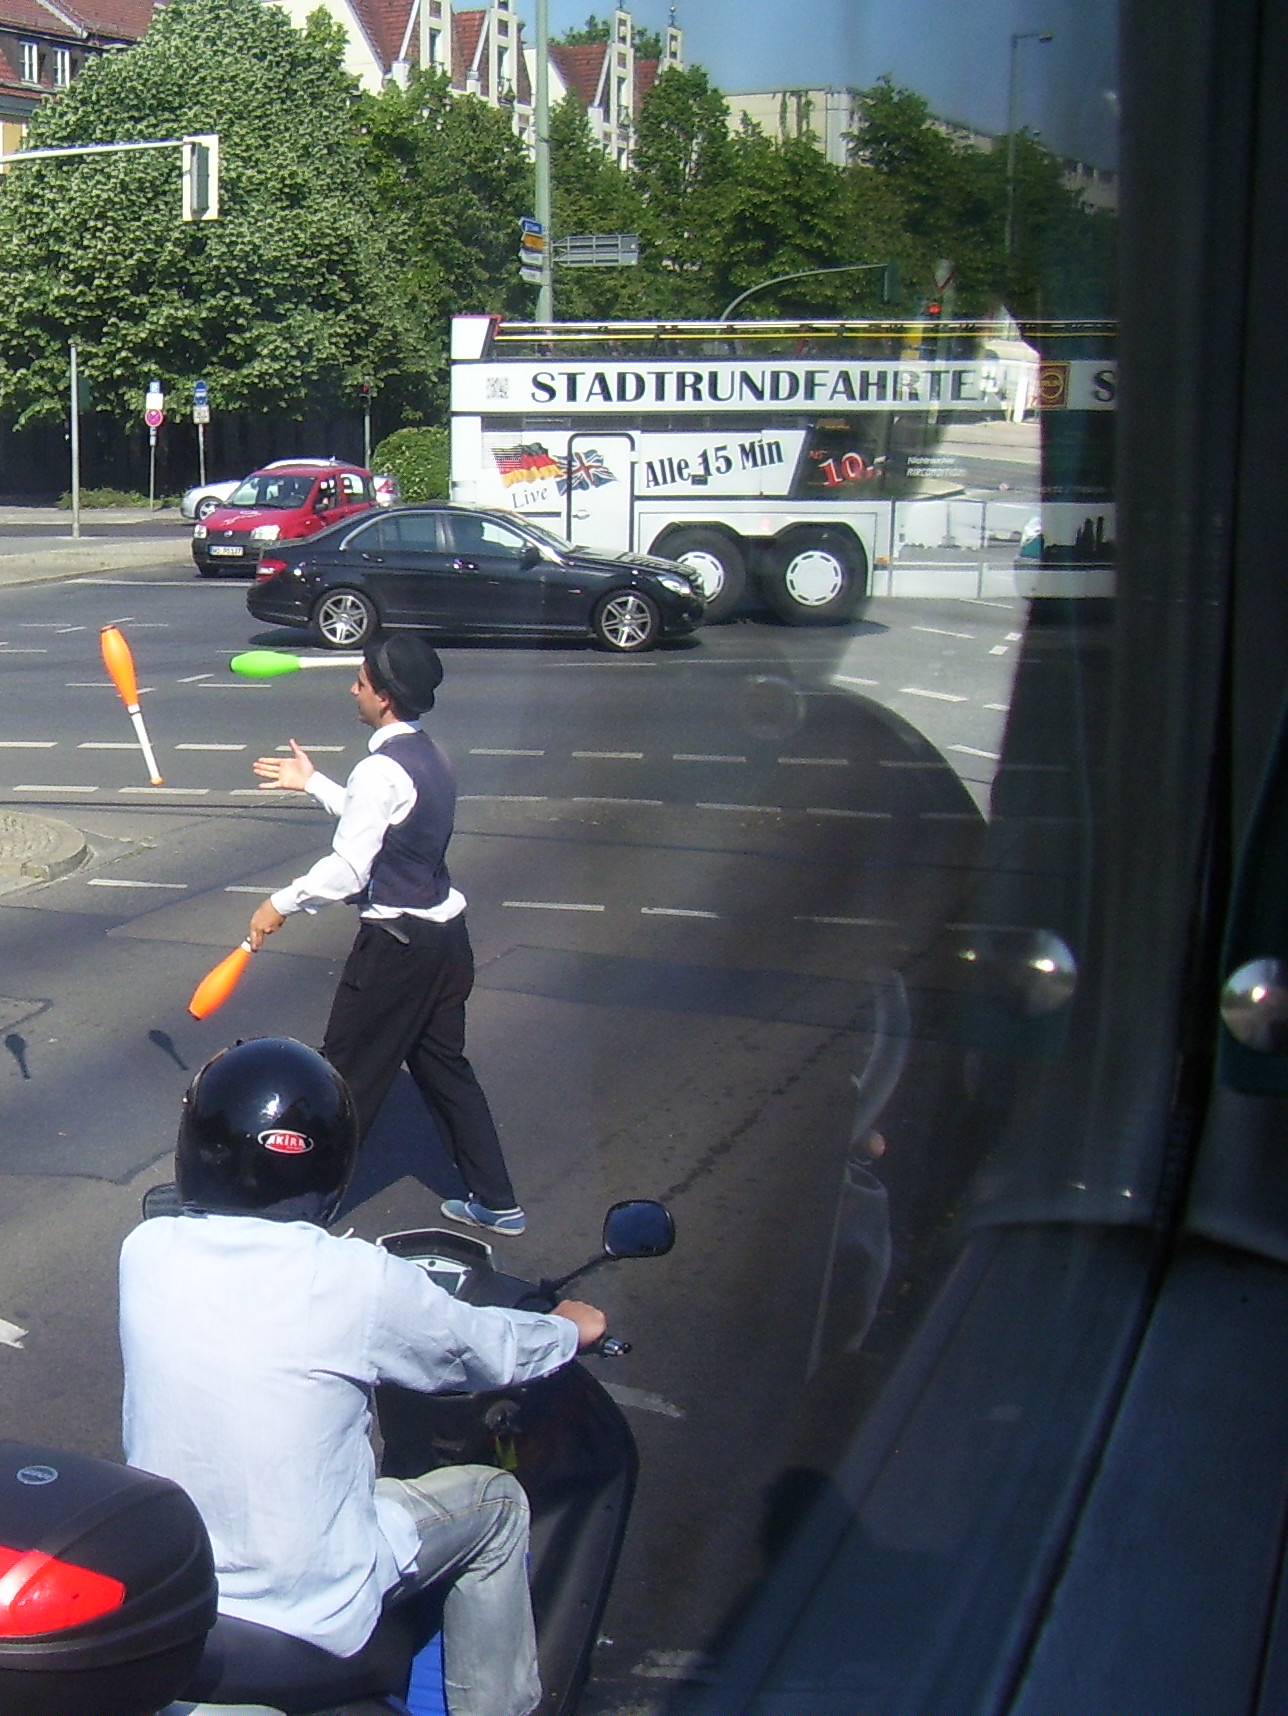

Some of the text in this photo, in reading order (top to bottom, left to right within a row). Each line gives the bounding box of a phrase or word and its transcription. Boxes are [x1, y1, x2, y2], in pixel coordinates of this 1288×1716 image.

[646, 438, 784, 488] Alle 15 Min
[512, 486, 548, 509] Live
[266, 1133, 307, 1149] AKIRA
